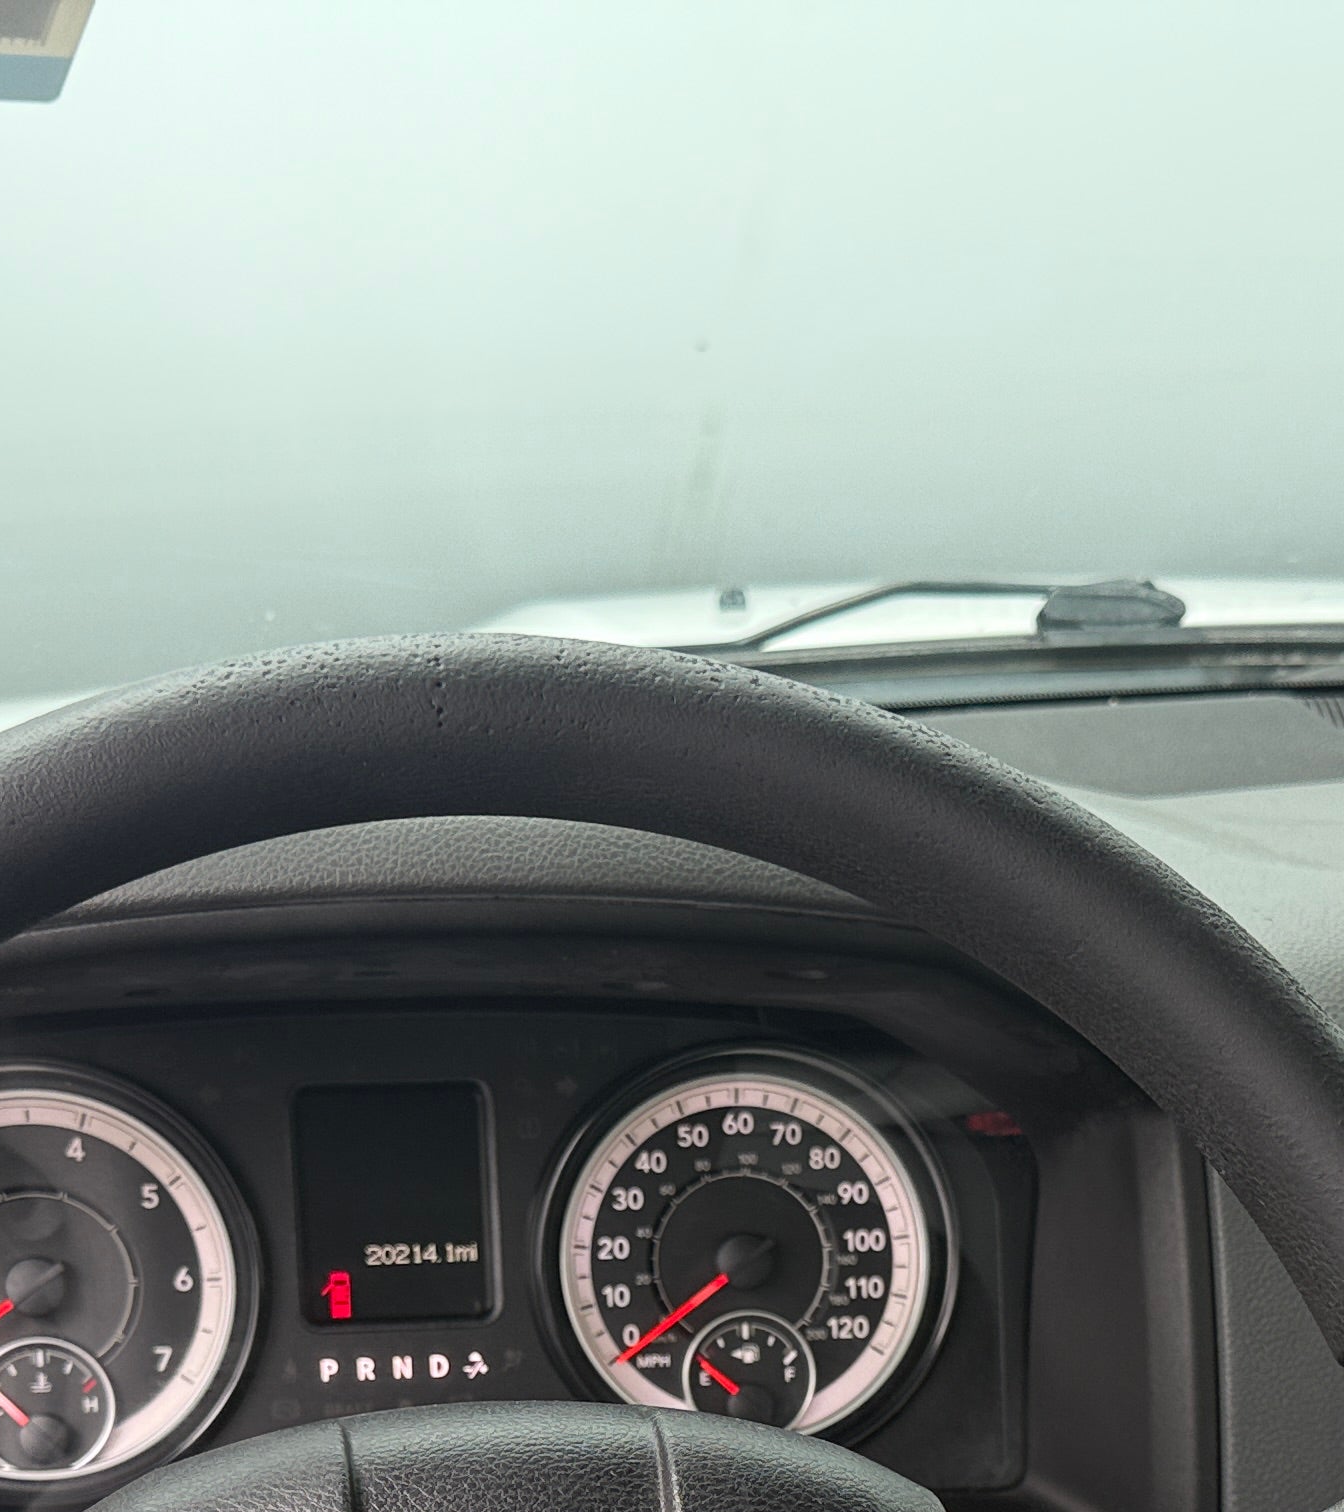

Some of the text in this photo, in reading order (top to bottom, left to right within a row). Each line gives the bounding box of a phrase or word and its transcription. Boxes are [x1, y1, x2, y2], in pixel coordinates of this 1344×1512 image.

[722, 1111, 754, 1135] 60
[769, 1121, 803, 1146] 70
[677, 1123, 709, 1148] 50
[66, 1138, 86, 1162] 4
[634, 1149, 668, 1174] 40
[809, 1146, 841, 1170] 80
[141, 1184, 160, 1209] 5
[611, 1186, 645, 1211] 30
[837, 1180, 869, 1205] 90
[597, 1236, 631, 1260] 20
[843, 1228, 886, 1252] 100
[173, 1266, 193, 1292] 6
[845, 1275, 885, 1299] 110
[601, 1283, 632, 1308] 10
[622, 1323, 641, 1347] 0
[826, 1315, 870, 1340] 120
[153, 1346, 172, 1372] 7
[319, 1353, 450, 1383] P R N D
[636, 1354, 672, 1369] MPH
[699, 1371, 712, 1387] E
[784, 1366, 796, 1383] F
[82, 1396, 99, 1413] H
